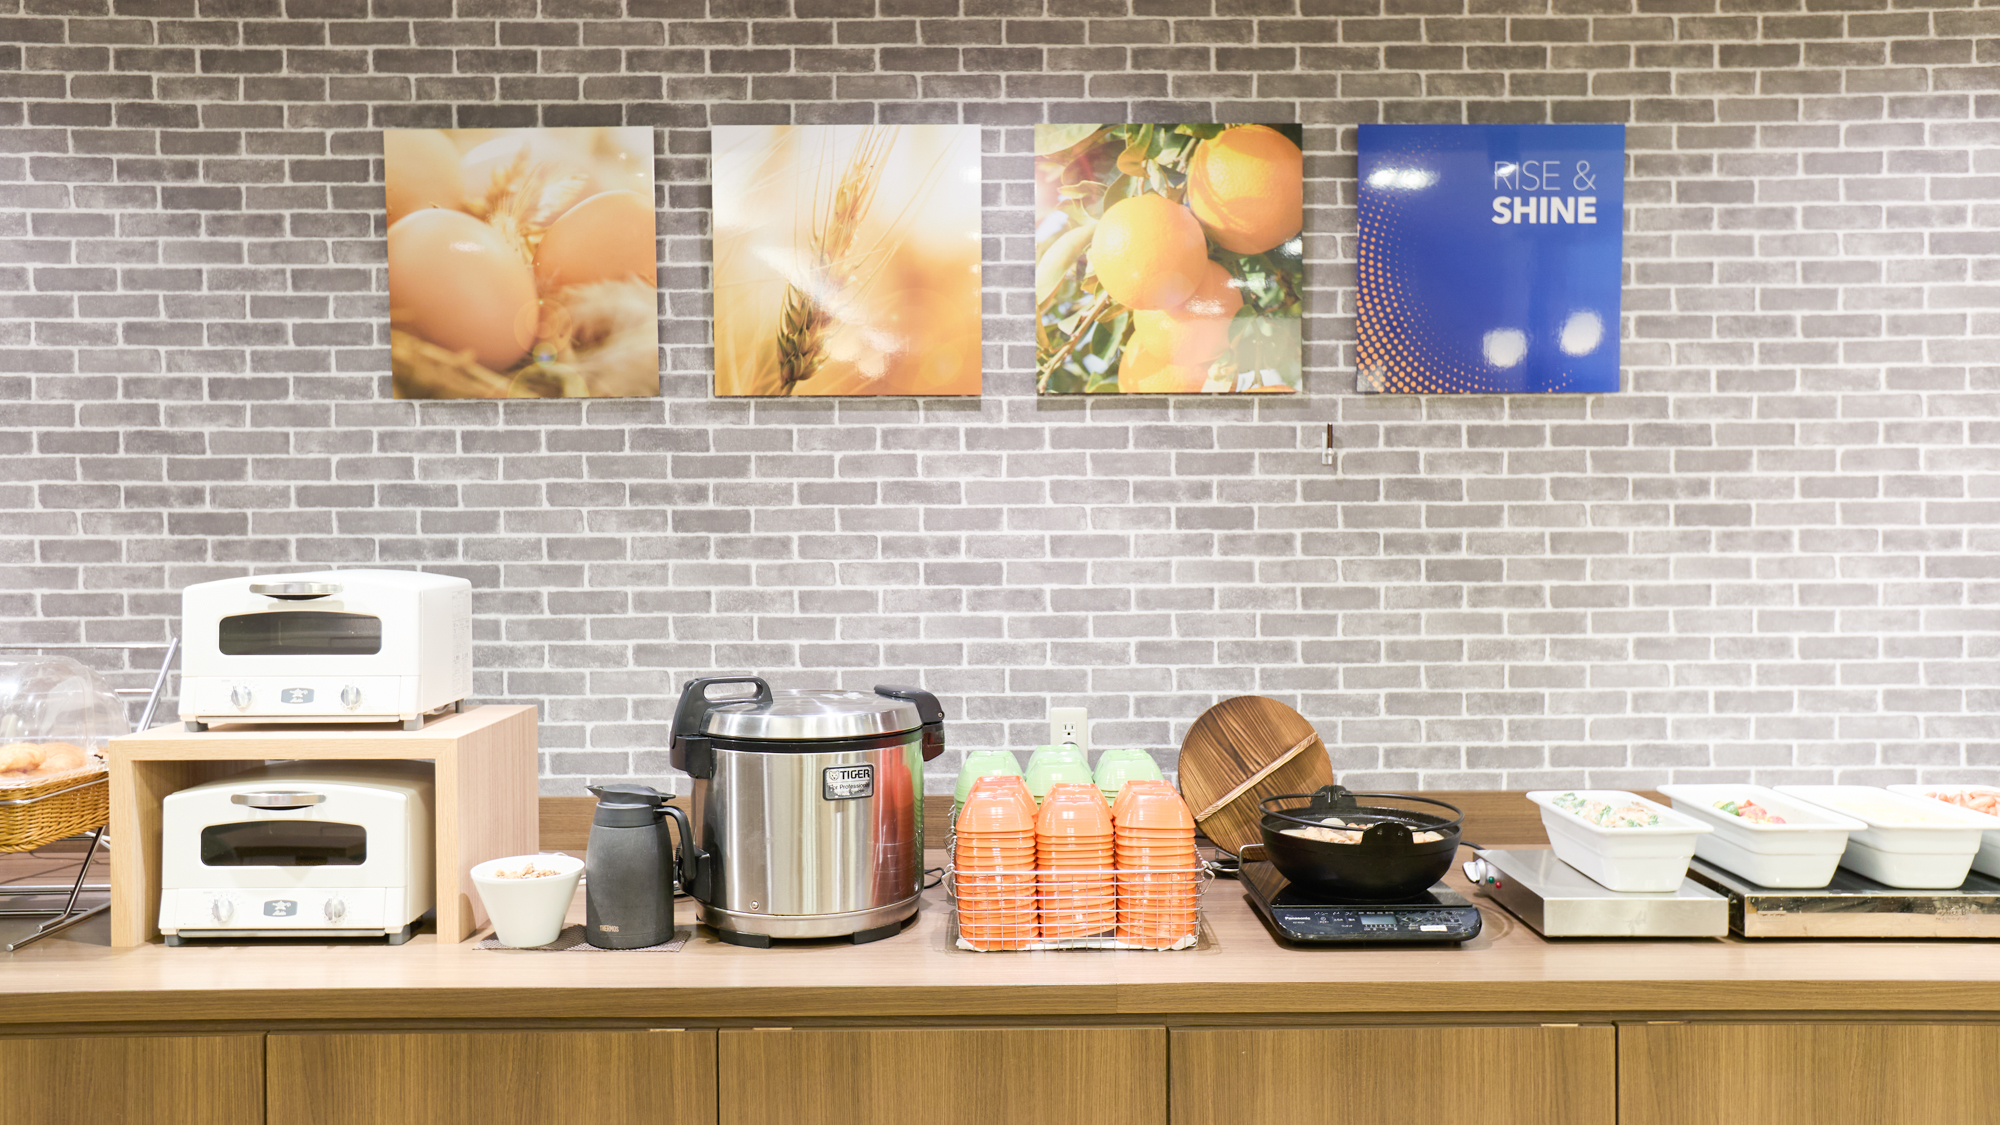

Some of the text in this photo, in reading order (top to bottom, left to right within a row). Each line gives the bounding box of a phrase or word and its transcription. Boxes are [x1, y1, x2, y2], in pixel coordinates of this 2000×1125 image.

[1494, 160, 1596, 191] RISE &
[1491, 196, 1597, 225] SHINE
[840, 769, 870, 780] TIGER
